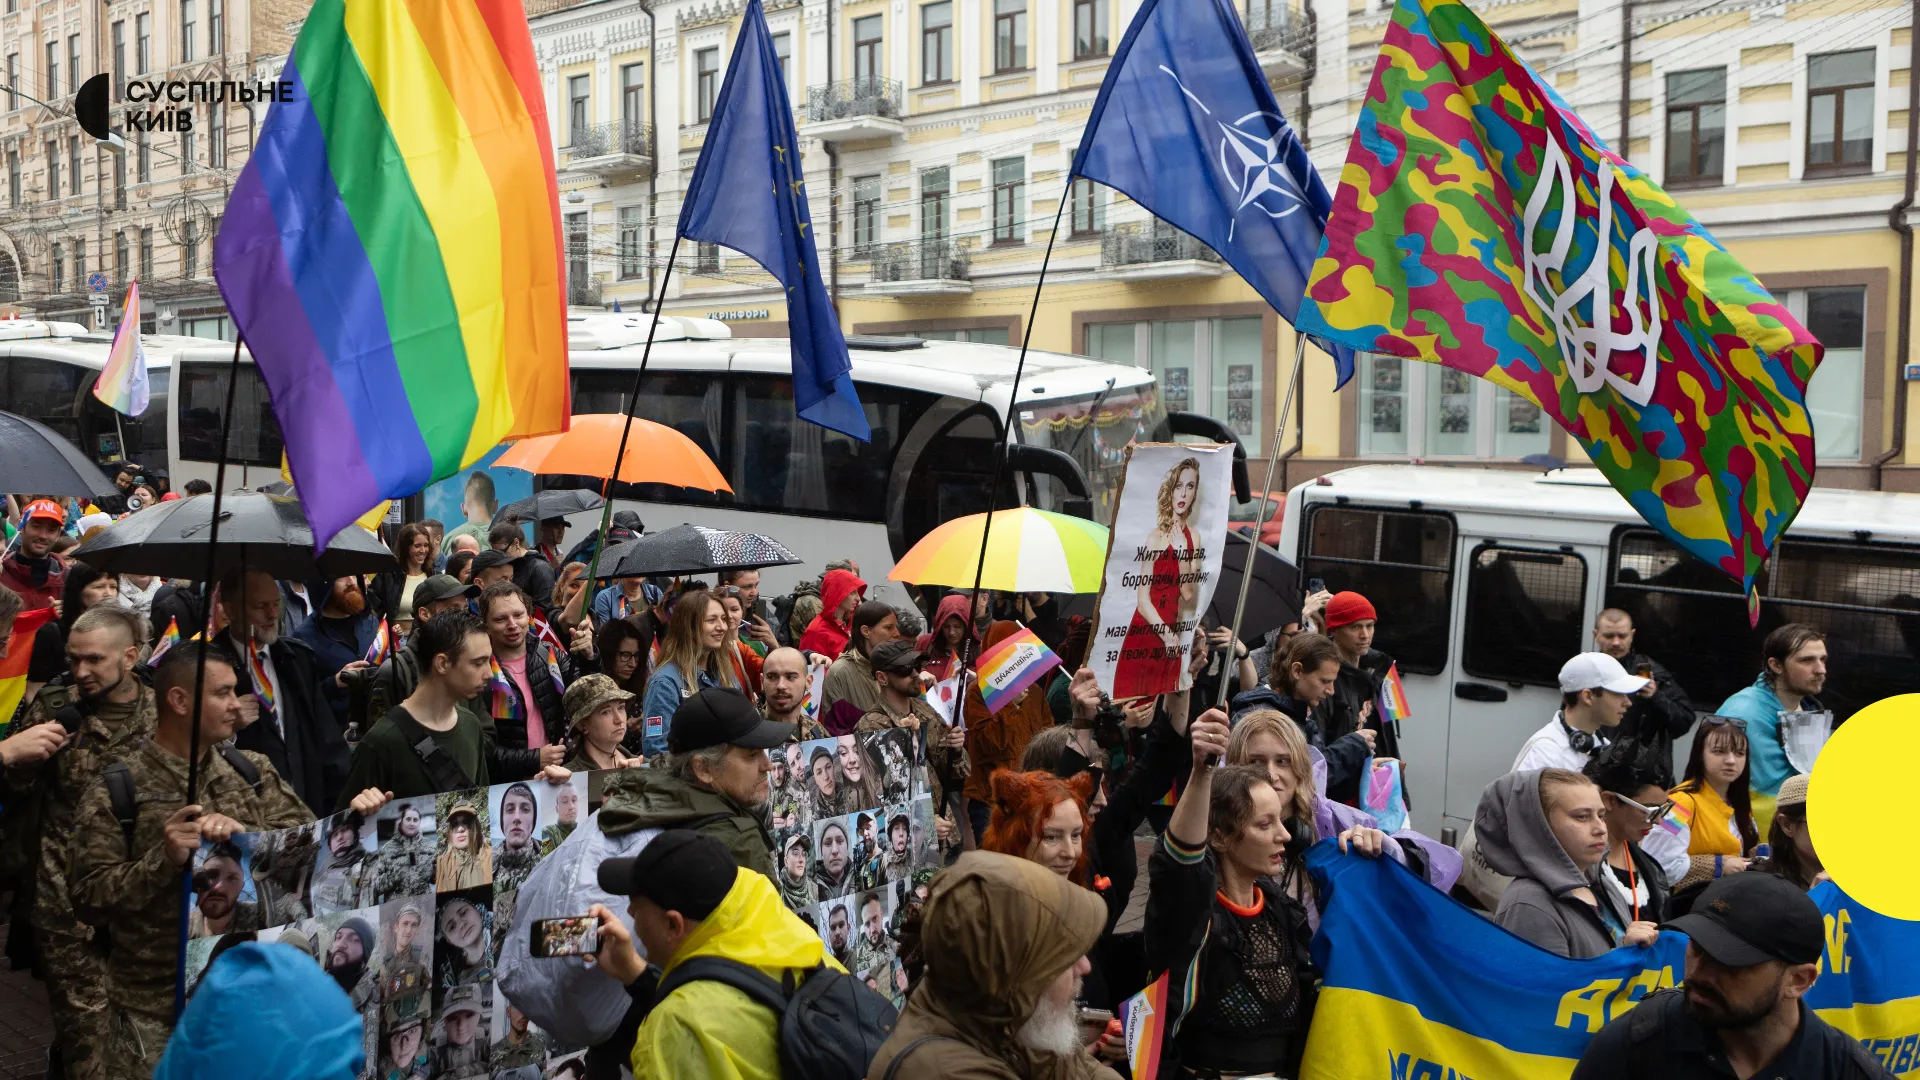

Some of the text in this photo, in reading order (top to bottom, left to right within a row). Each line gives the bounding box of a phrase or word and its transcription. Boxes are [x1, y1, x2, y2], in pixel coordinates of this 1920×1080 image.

[39, 501, 58, 515] NL
[1134, 545, 1206, 561] Життя віддав,
[1105, 625, 1128, 638] мав
[1129, 623, 1165, 637] вигляд
[1106, 650, 1118, 662] за
[1121, 648, 1148, 661] твою
